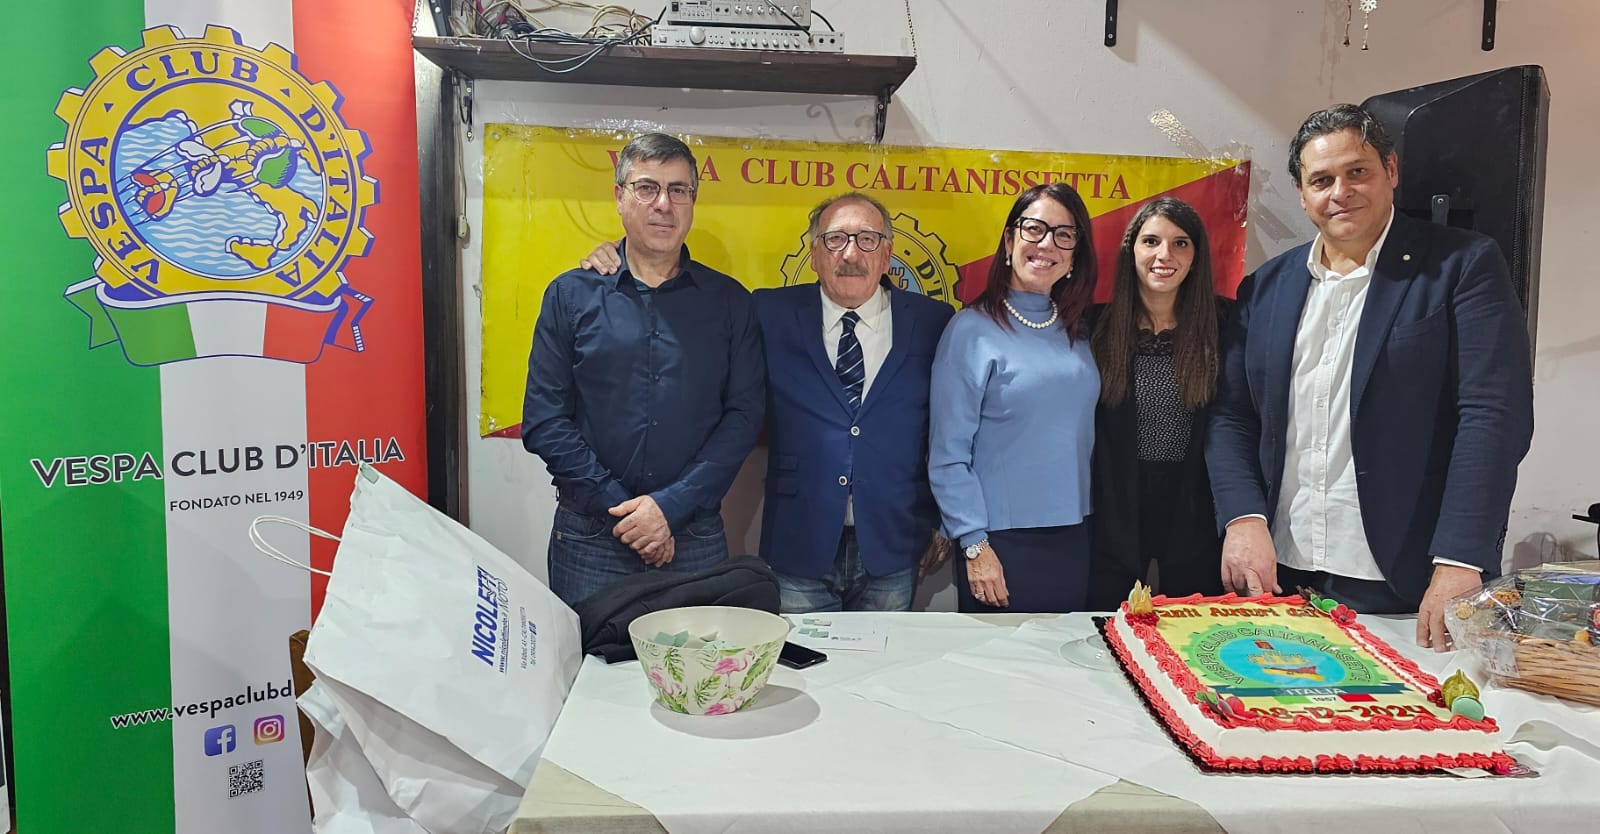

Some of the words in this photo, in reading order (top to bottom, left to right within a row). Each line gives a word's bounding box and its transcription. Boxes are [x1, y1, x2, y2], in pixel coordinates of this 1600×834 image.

[79, 137, 160, 285] VESPA
[126, 51, 260, 92] CLUB
[275, 103, 350, 288] D'ITALIA
[740, 156, 835, 187] CLUB
[31, 452, 164, 488] VESPA
[171, 445, 264, 477] CLUB
[275, 437, 404, 470] D'ITALIA
[169, 494, 241, 511] FONDATO
[245, 492, 272, 504] NEL
[274, 490, 304, 502] 1949
[1199, 629, 1238, 652] CLUB
[111, 679, 292, 729] www.vespaclubd
